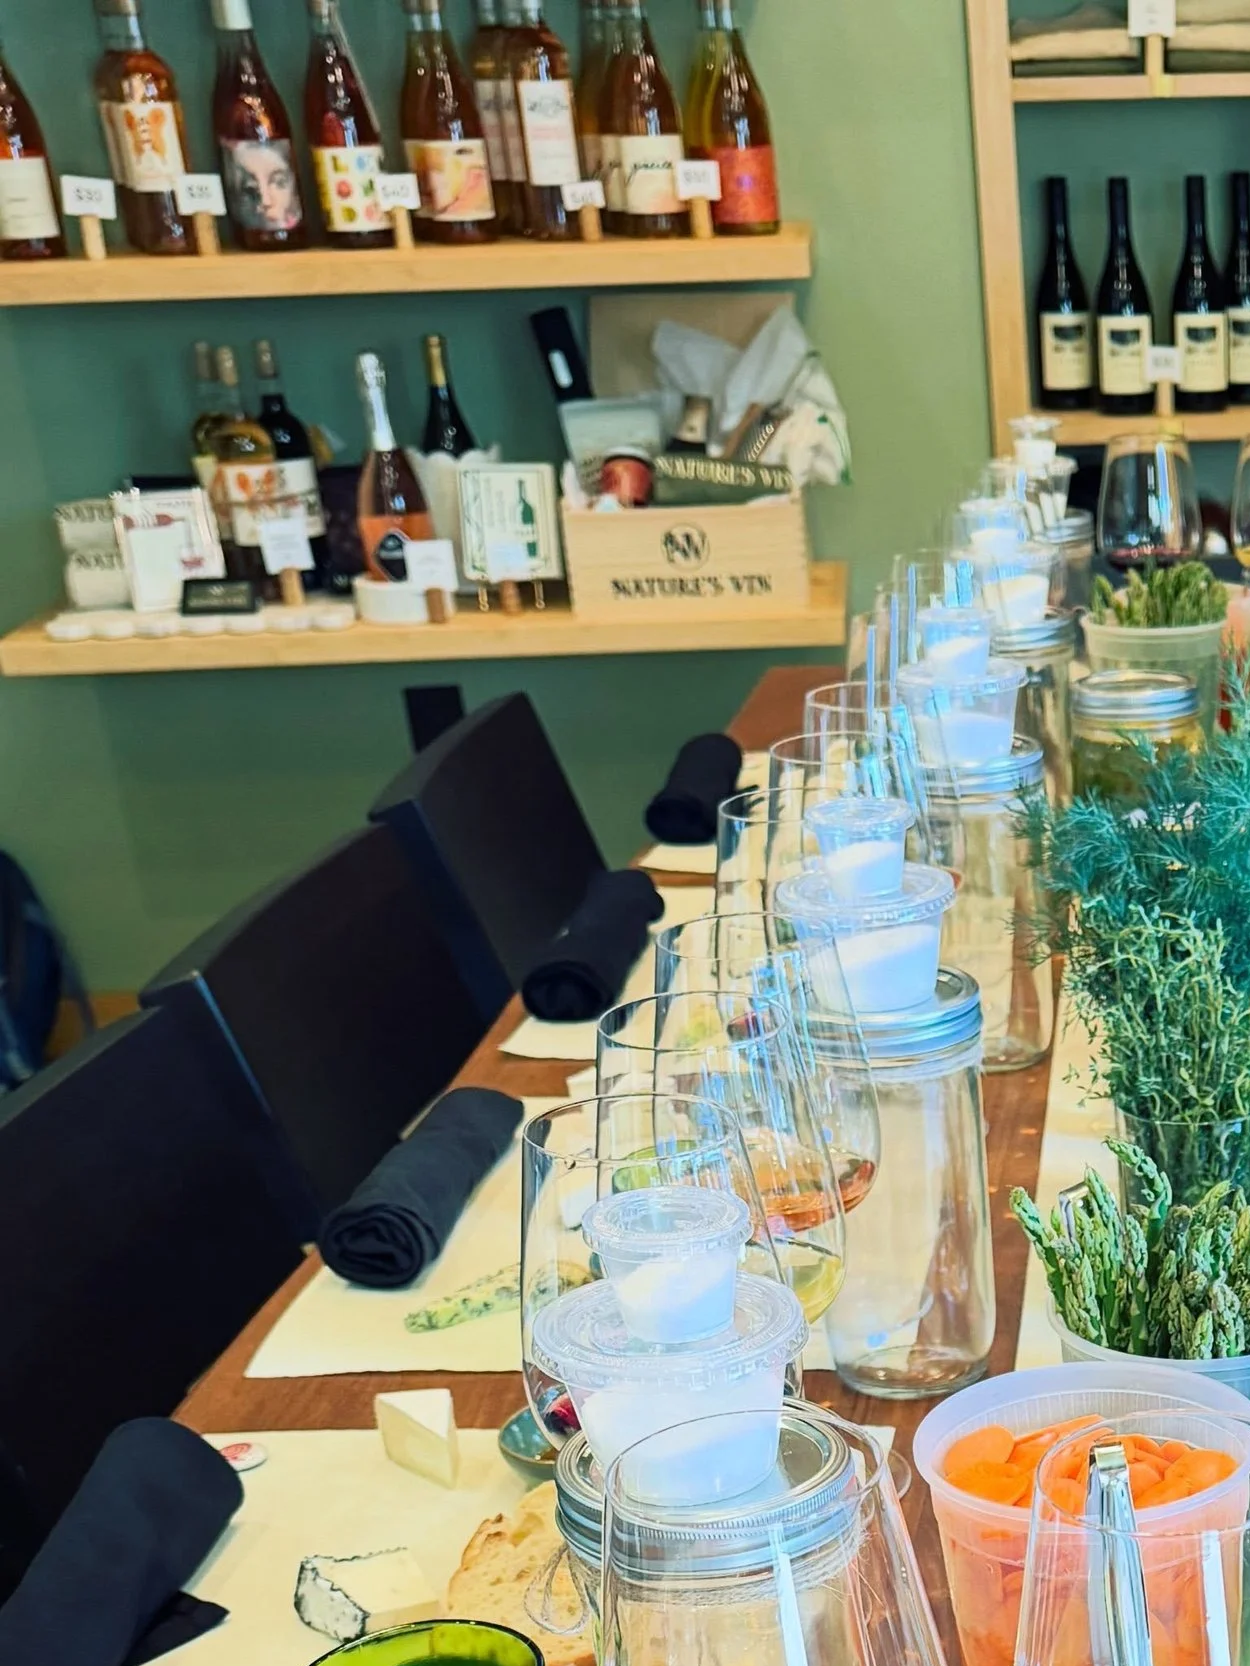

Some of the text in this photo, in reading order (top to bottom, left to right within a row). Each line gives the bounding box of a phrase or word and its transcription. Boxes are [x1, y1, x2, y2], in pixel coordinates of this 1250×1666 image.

[655, 456, 756, 487] NATURE'S
[611, 574, 773, 600] NATURE'S VIN
